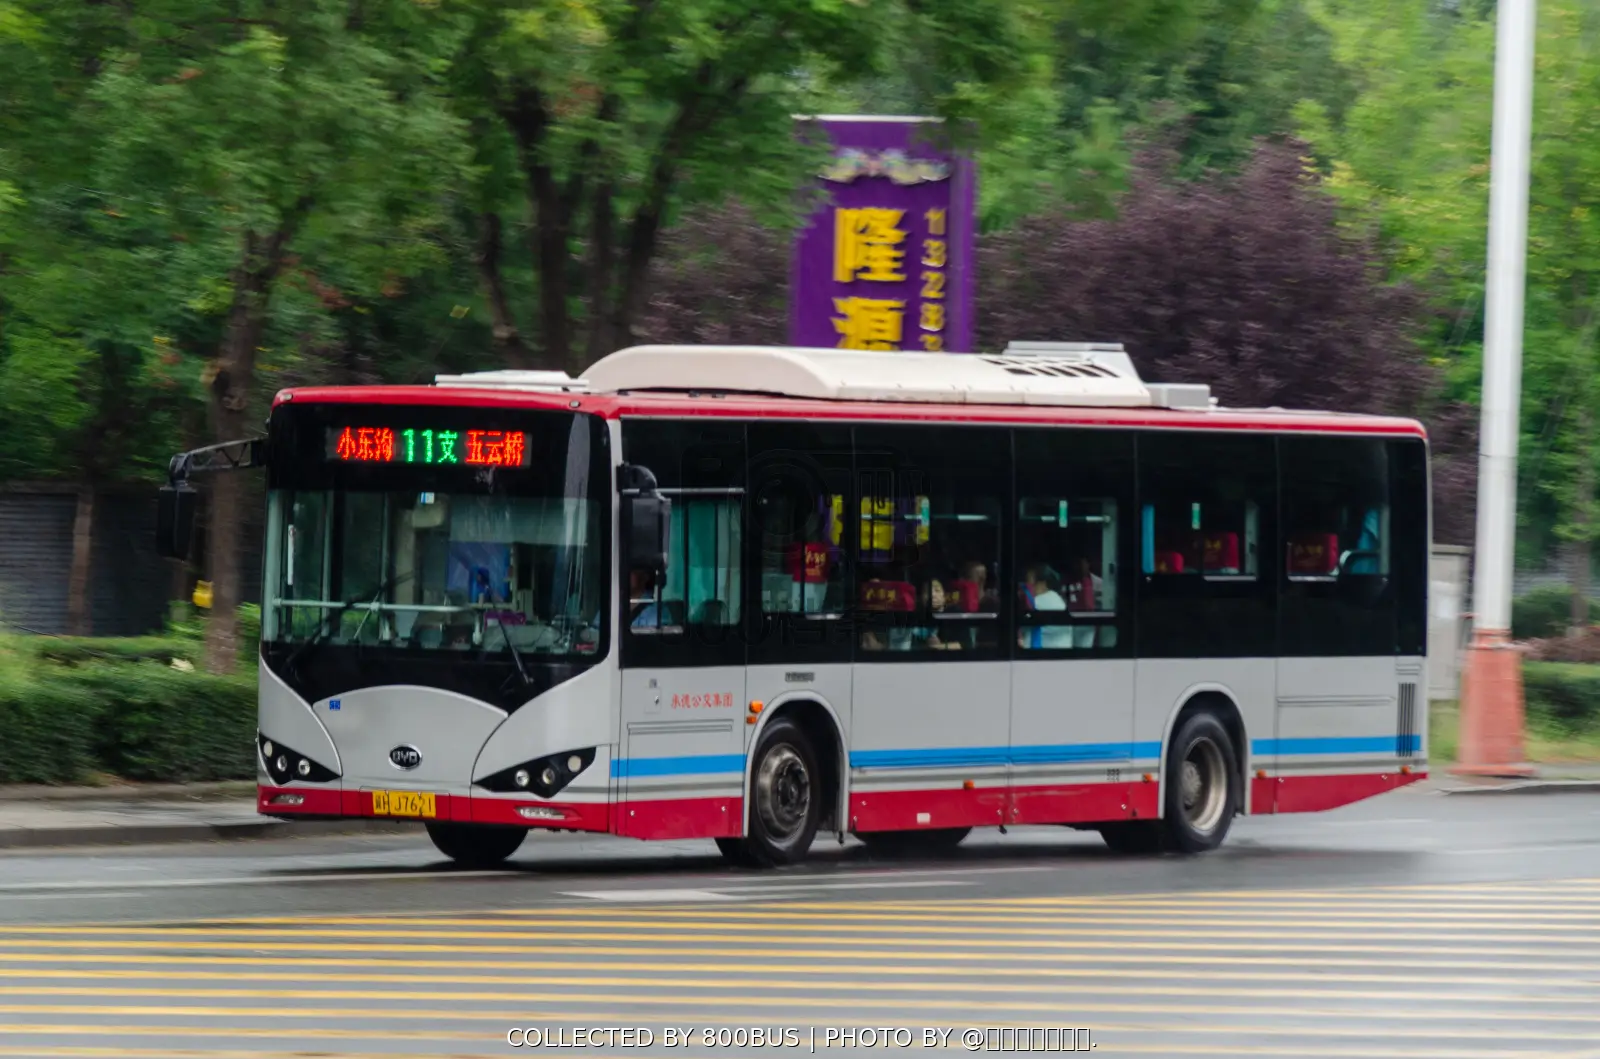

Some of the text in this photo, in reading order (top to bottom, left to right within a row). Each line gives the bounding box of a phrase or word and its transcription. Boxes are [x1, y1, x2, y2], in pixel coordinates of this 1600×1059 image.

[336, 426, 525, 467] 小东沟 11支 五云桥
